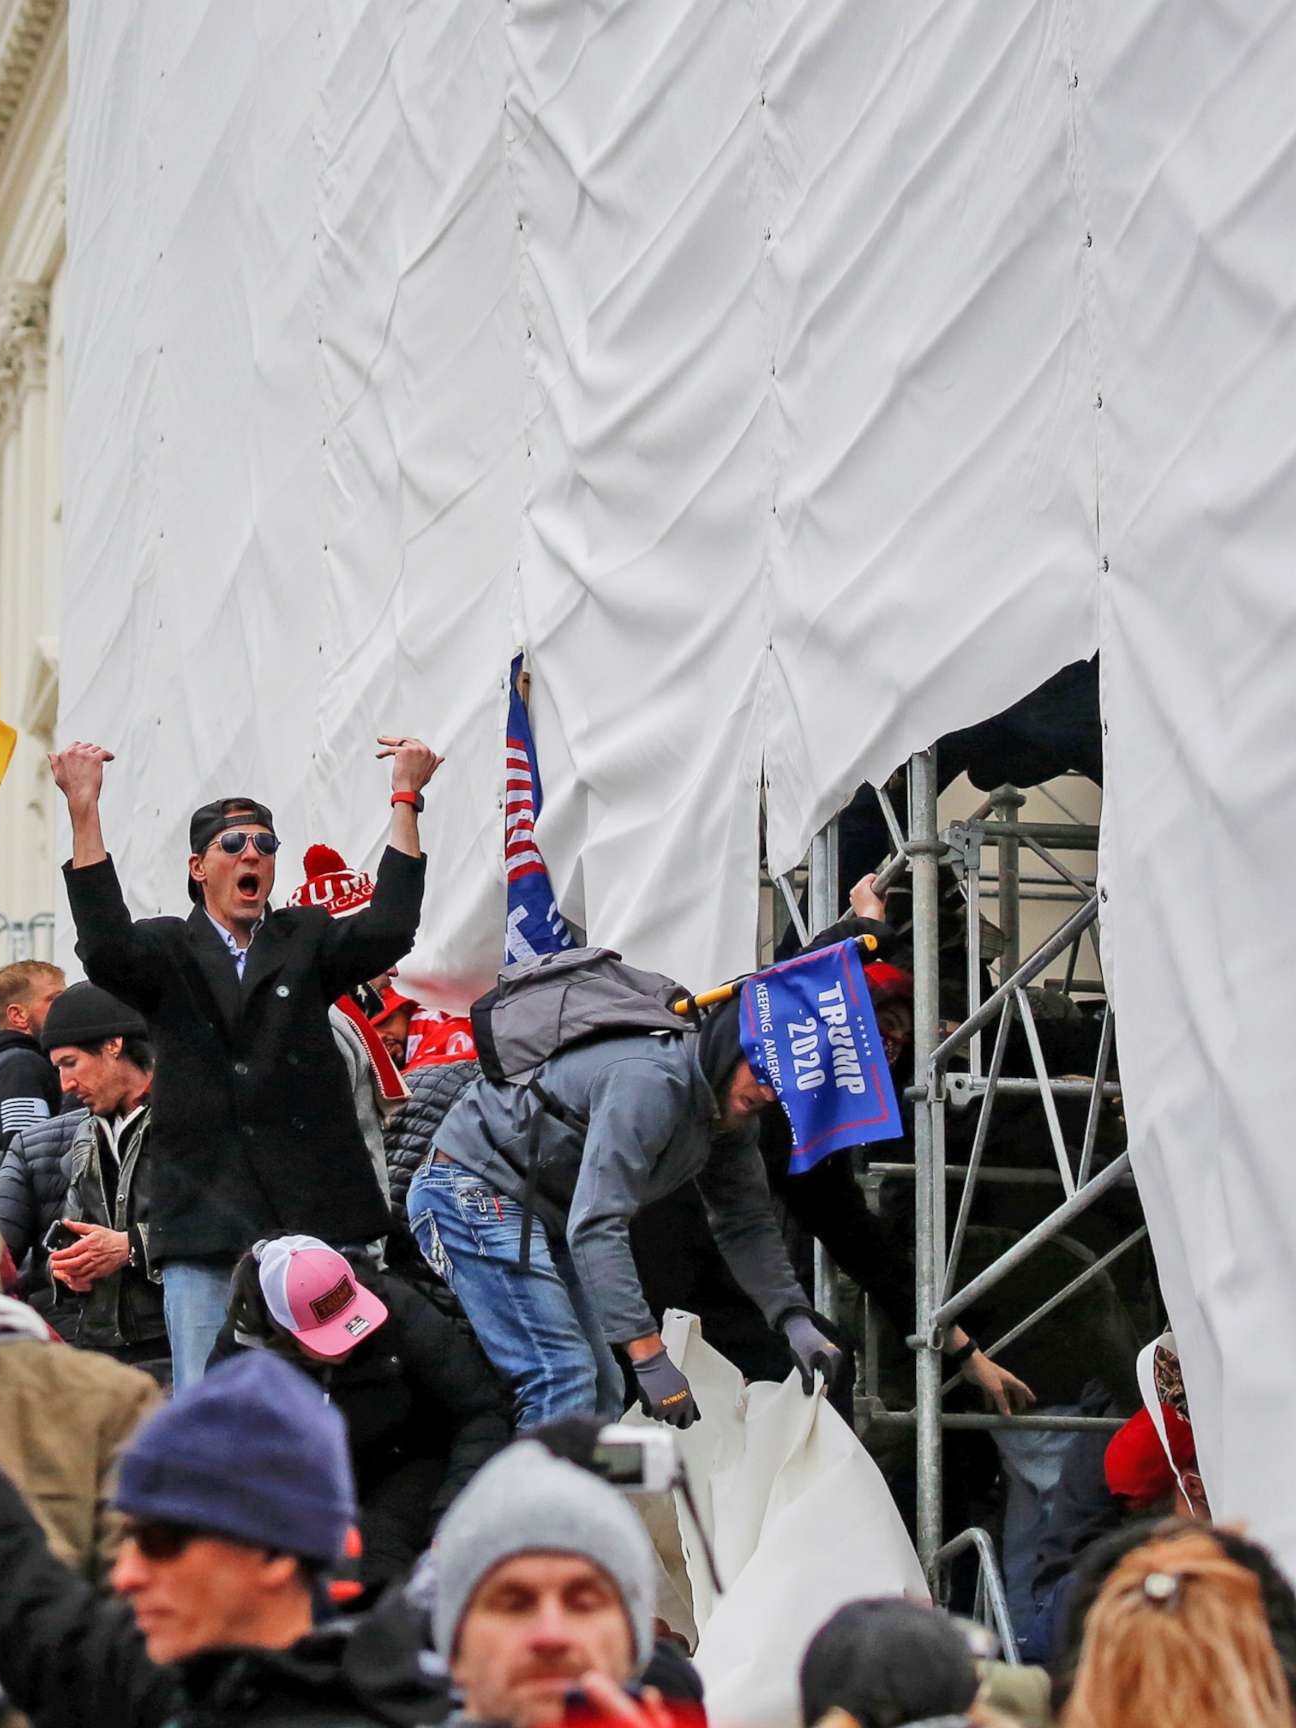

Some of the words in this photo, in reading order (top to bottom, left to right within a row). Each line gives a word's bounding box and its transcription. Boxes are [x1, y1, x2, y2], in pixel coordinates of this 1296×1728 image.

[755, 982, 773, 1033] KEEPING
[818, 980, 866, 1094] TRUMP
[762, 1038, 784, 1095] AMERICA
[787, 1016, 826, 1091] 2020
